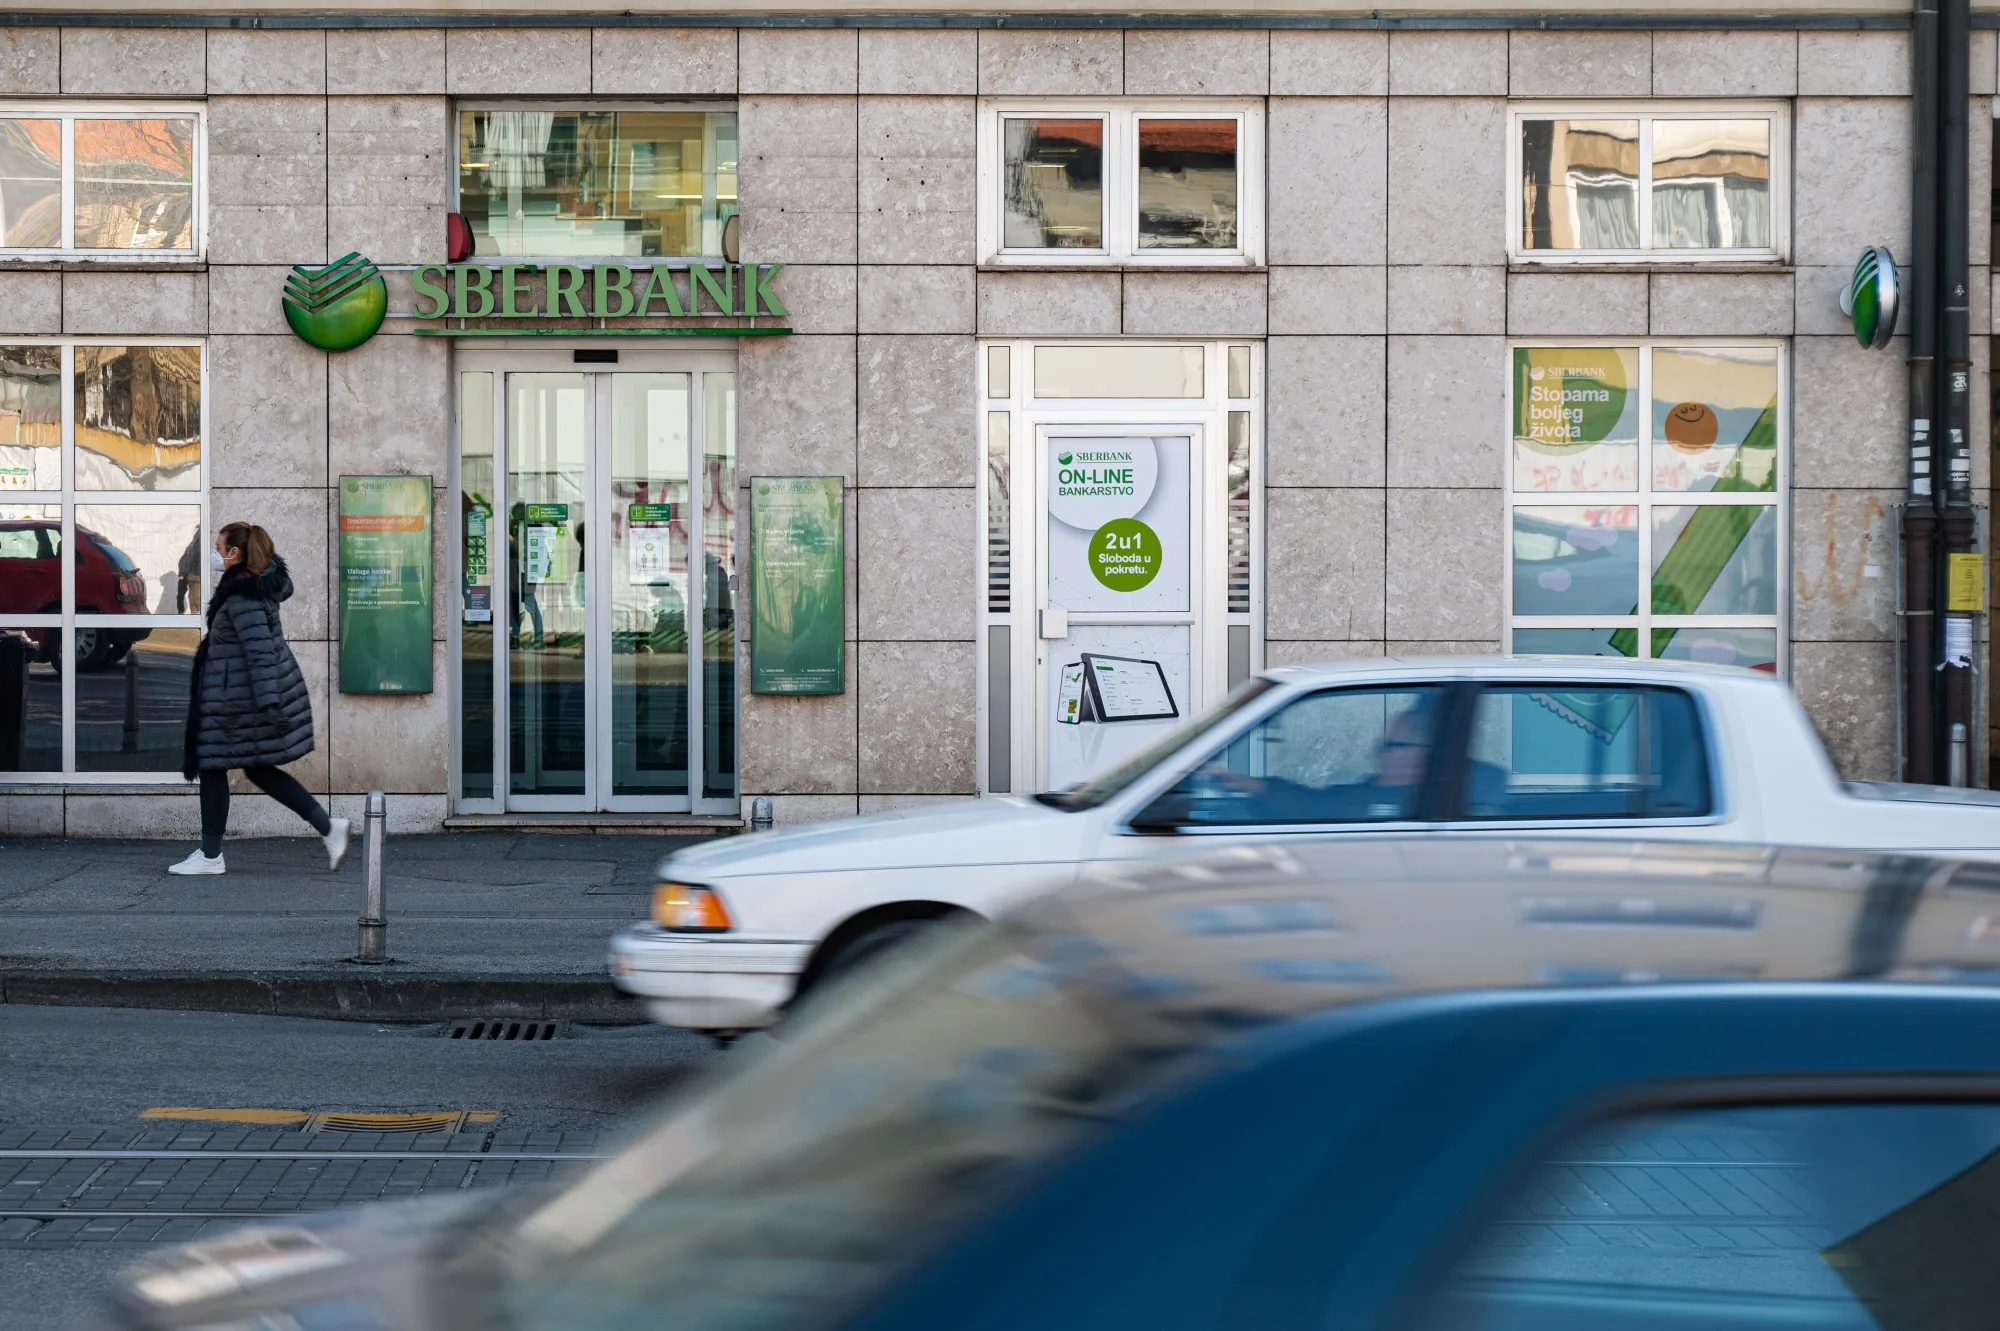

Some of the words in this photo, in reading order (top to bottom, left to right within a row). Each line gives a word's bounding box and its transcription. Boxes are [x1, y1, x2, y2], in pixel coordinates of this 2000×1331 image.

[411, 263, 790, 319] SBERBANK
[1548, 367, 1606, 377] SBERBANK
[1531, 386, 1609, 405] Stopama
[1531, 405, 1583, 424] boljeg
[1530, 422, 1581, 438] života
[1076, 452, 1133, 461] SBERBANK
[1058, 469, 1134, 485] ON-LINE
[1058, 486, 1134, 496] BANKARSTVO
[1098, 553, 1142, 563] Sloboda
[347, 568, 371, 577] Usluge
[371, 568, 392, 576] banke
[1105, 565, 1148, 577] pokretu.
